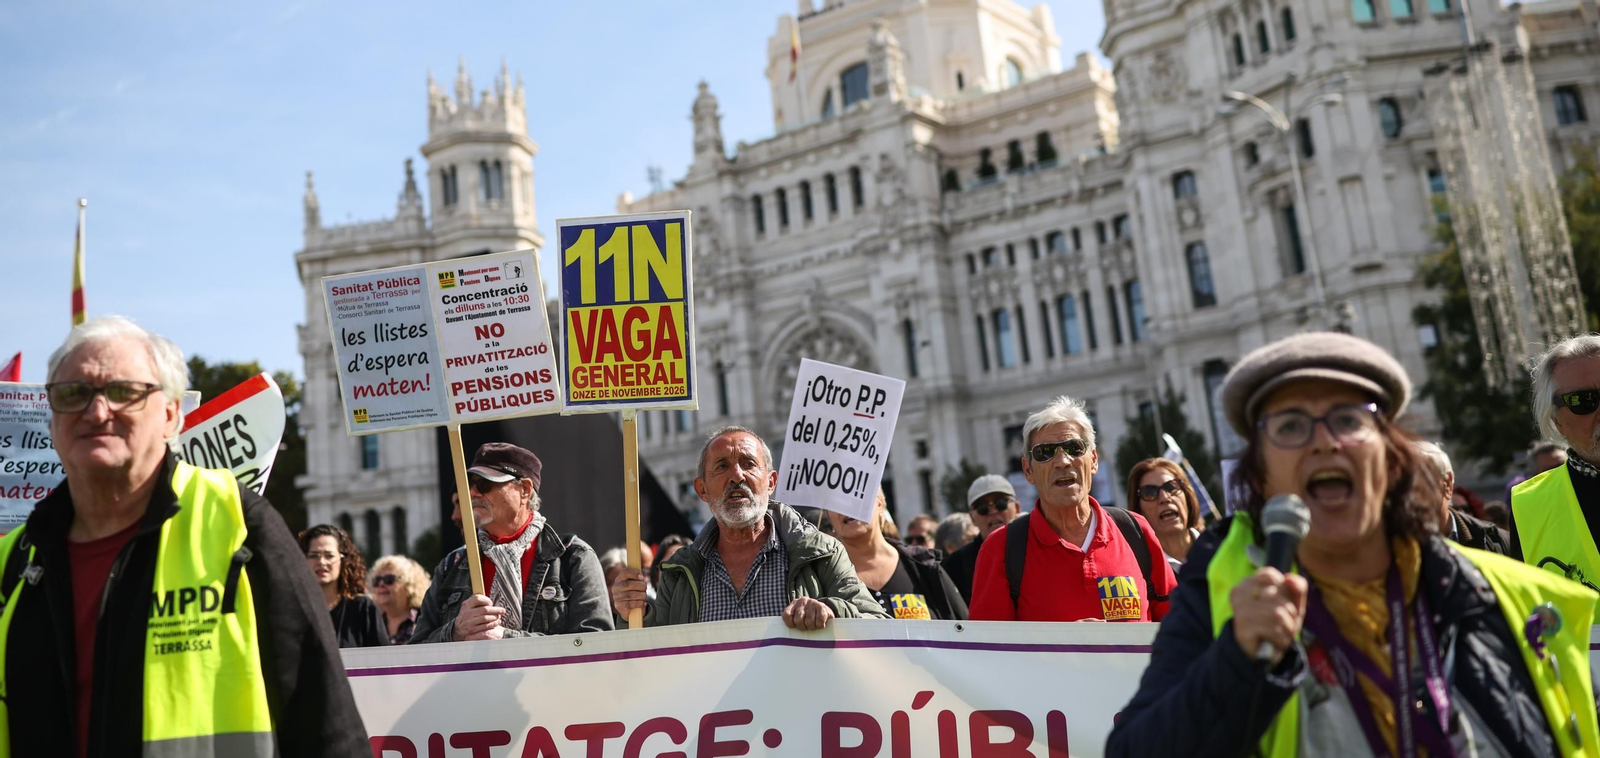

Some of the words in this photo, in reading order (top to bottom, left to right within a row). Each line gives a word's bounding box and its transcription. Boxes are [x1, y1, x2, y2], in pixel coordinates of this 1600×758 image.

[565, 222, 684, 304] 11N
[332, 283, 373, 296] Sanitat
[377, 277, 420, 290] Pública
[371, 288, 408, 300] Terrassa
[441, 282, 528, 305] Concentració
[395, 304, 421, 312] Terrassa
[444, 307, 454, 315] els
[455, 301, 486, 313] dilluns
[492, 300, 502, 308] les
[503, 294, 530, 306] 10:30
[446, 315, 464, 324] Davant
[506, 305, 531, 314] Terrassa
[342, 328, 366, 347] les
[374, 323, 428, 343] llistes
[474, 322, 505, 340] NO
[570, 305, 683, 364] VAGA
[347, 351, 429, 376] d'espera
[446, 342, 548, 368] PRIVATITZACIÓ
[571, 361, 684, 389] GENERAL
[353, 373, 430, 400] maten!
[572, 390, 596, 399] ONZE
[598, 389, 610, 398] DE
[612, 387, 662, 398] NOVEMBRE
[663, 386, 685, 395] 2026
[803, 375, 852, 408] ¡Otro
[855, 384, 887, 417] P.P.
[792, 415, 821, 444] del
[823, 419, 880, 465] 0,25%,
[786, 458, 870, 499] ¡¡NOOO!!
[1098, 576, 1140, 598] 11N
[149, 585, 220, 618] MPD
[891, 594, 927, 607] 11N
[895, 606, 928, 616] VAGA
[1102, 597, 1140, 611] VAGA
[153, 640, 212, 655] TERRASSA
